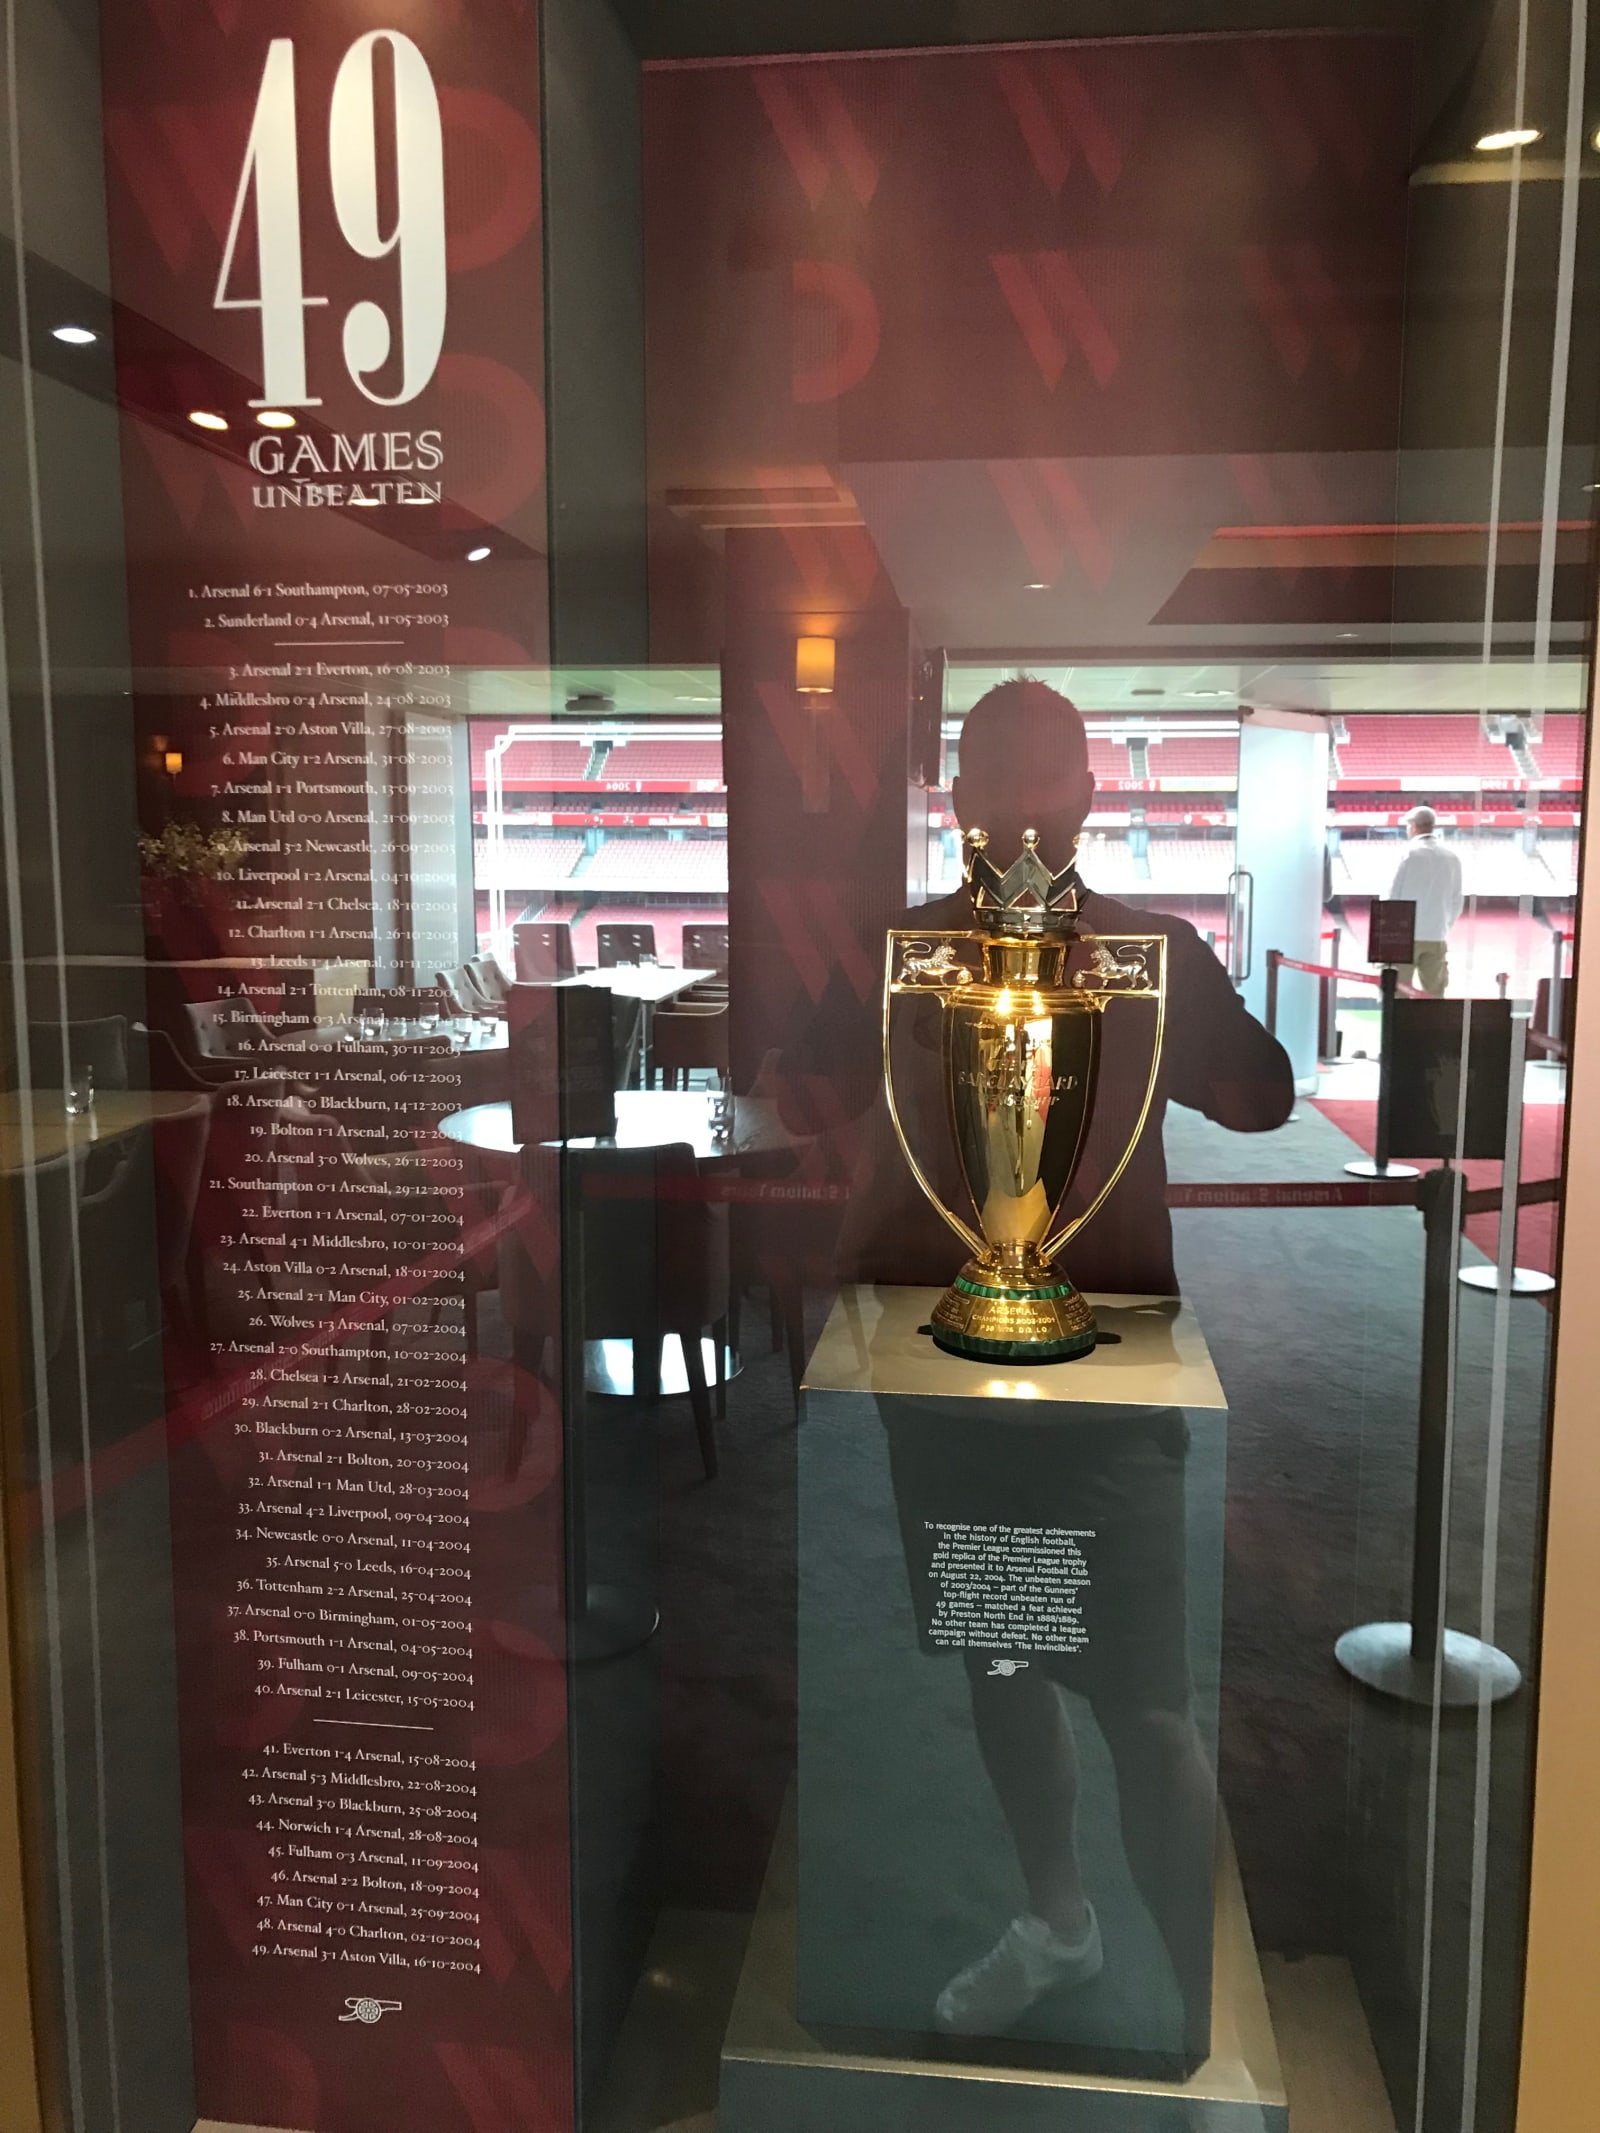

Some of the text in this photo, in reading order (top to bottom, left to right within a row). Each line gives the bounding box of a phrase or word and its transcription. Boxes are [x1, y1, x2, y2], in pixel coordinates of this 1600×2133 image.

[213, 29, 448, 407] 49
[250, 430, 444, 474] GAMES
[252, 481, 442, 508] UNBEATEN
[201, 583, 250, 598] Arsenal
[253, 587, 272, 597] 6-1
[275, 582, 370, 600] Southampton,
[372, 584, 448, 598] 07-05-2003
[218, 612, 292, 628] Sunderland
[295, 617, 317, 629] 0-4
[320, 611, 375, 627] Arsenal,
[378, 614, 449, 627] 11-05-2003
[209, 1177, 464, 1199] 21. Southampton 0-1 Arsenal, 29-12-2003
[220, 1232, 464, 1255] 23. Arsenal 4-1 Middlesbro, 10-01-2004
[250, 1368, 468, 1392] 28. Chelsea 1-2 Arsenal, 21-02-2004
[234, 1421, 468, 1447] 30. Blackburn 0-2 Arsenal, 13-03-2004
[238, 1501, 470, 1527] 33. Arsenal 4-2 Liverpool, 09-04-2004
[924, 1521, 934, 1530] To
[935, 1523, 971, 1532] recognise
[989, 1524, 998, 1533] of
[998, 1525, 1012, 1534] the
[1013, 1527, 1044, 1535] greatest
[1045, 1527, 1096, 1538] achievements
[938, 1541, 1082, 1556] the Premier League commissioned this
[953, 1532, 967, 1541] the
[969, 1533, 997, 1544] history
[999, 1534, 1009, 1543] of
[1010, 1535, 1040, 1545] English
[1042, 1536, 1076, 1547] football,
[931, 1561, 1088, 1576] and presented it to Arsenal Football Club
[932, 1551, 1087, 1568] gold replica of the Premier League trophy
[940, 1570, 967, 1581] August
[1008, 1574, 1023, 1583] The
[1025, 1575, 1062, 1584] unbeaten
[1063, 1578, 1091, 1586] season
[940, 1580, 949, 1589] of
[951, 1581, 991, 1592] 2003/2004
[1000, 1584, 1017, 1593] part
[1018, 1584, 1028, 1592] of
[1029, 1584, 1042, 1593] the
[943, 1590, 980, 1601] top-flight
[982, 1593, 1008, 1601] record
[1010, 1593, 1048, 1603] unbeaten
[1066, 1596, 1076, 1605] of
[935, 1601, 946, 1609] 49
[984, 1602, 1019, 1611] matched
[1029, 1603, 1044, 1613] feat
[1046, 1605, 1083, 1615] achieved
[938, 1608, 949, 1619] by
[950, 1609, 981, 1619] Preston
[983, 1611, 1006, 1620] North
[1008, 1612, 1024, 1621] End
[1026, 1613, 1034, 1621] in
[228, 1604, 472, 1633] 37. Arsenal 0-0 Birmingham, 01-05-2004
[931, 1618, 943, 1626] No
[945, 1619, 967, 1627] other
[968, 1620, 989, 1628] team
[991, 1621, 1005, 1630] has
[1007, 1623, 1050, 1633] completed
[1059, 1624, 1087, 1634] league
[928, 1628, 1089, 1643] campaign without defeat. No other team
[951, 1638, 966, 1647] call
[968, 1638, 1012, 1649] themselves
[263, 1743, 476, 1772] 41. Everton 1-4 Arsenal, 15-08-2004
[268, 1844, 479, 1874] 45. Fulham 0-3 Arsenal, 11-09-2004
[252, 1944, 481, 1975] 49. Arsenal 3-1 Aston Villa, 16-10-2004
